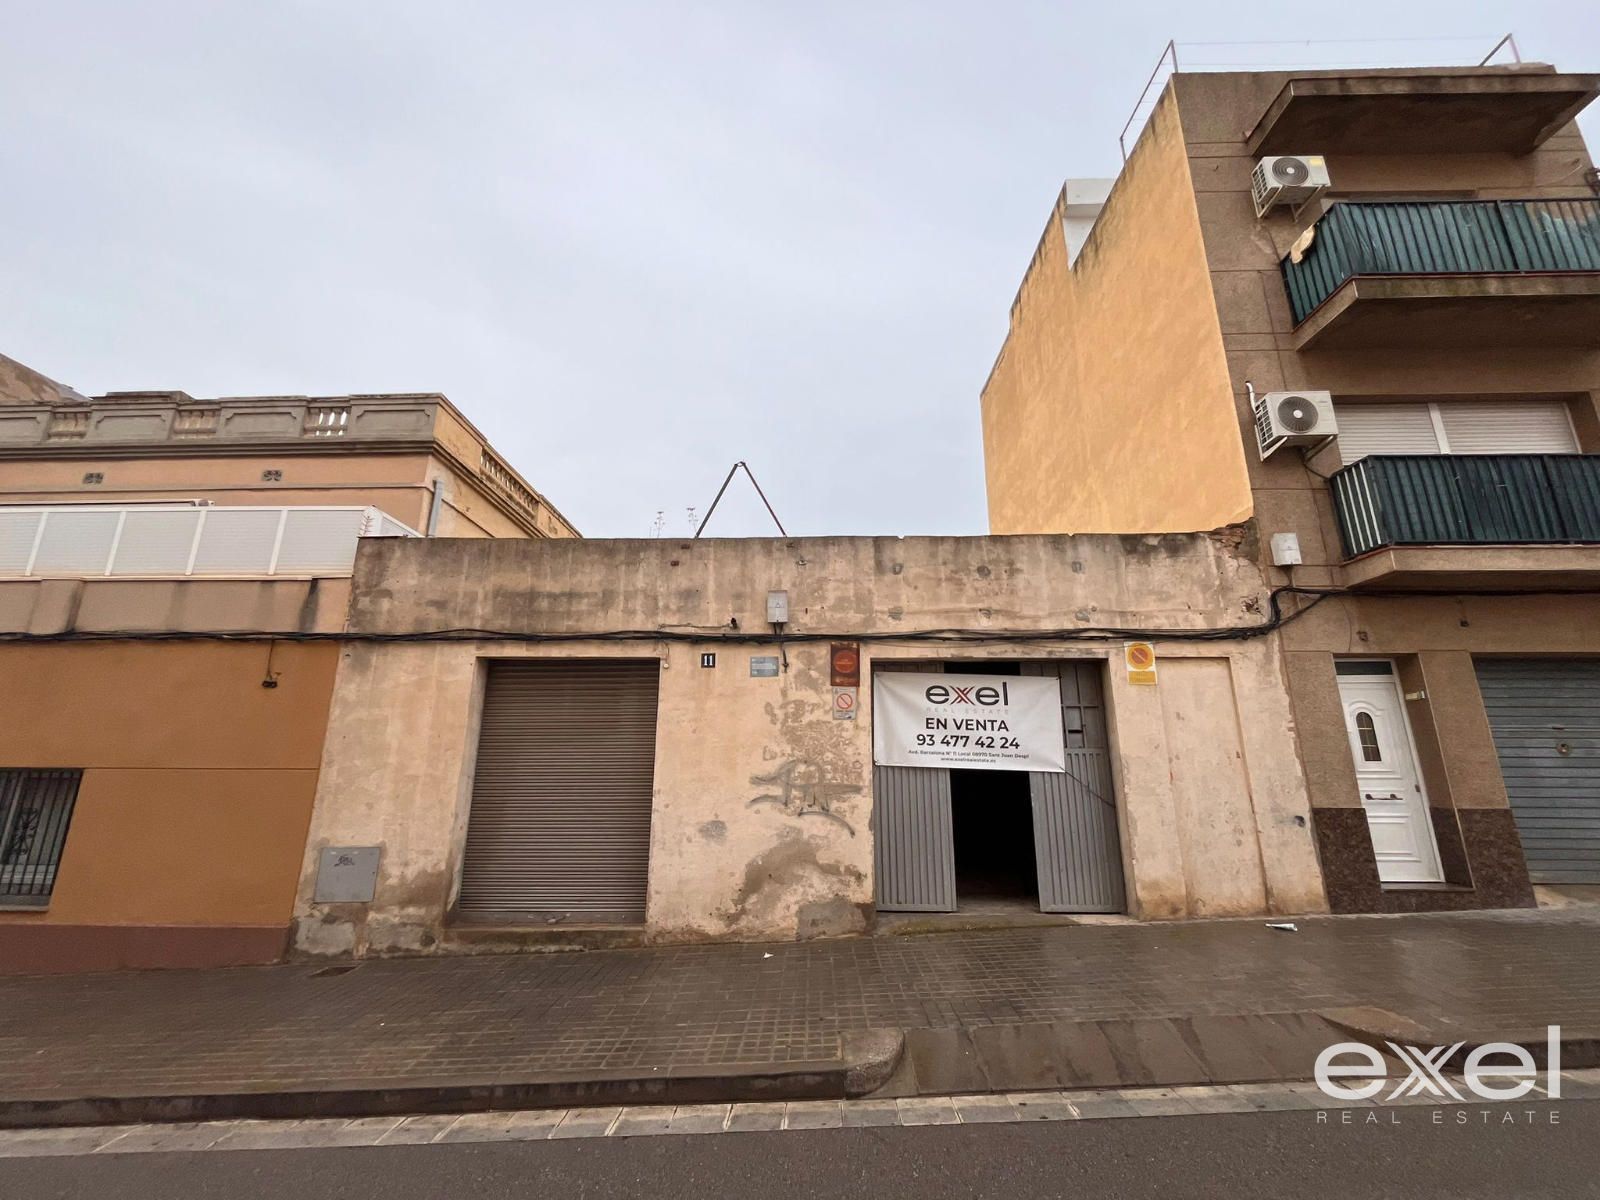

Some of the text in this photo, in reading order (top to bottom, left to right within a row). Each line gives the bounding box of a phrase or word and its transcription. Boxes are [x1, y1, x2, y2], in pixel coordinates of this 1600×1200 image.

[704, 655, 713, 666] 11
[925, 681, 1009, 706] exel
[926, 717, 1009, 732] EN VENTA
[917, 734, 1020, 749] 93 477 42 24
